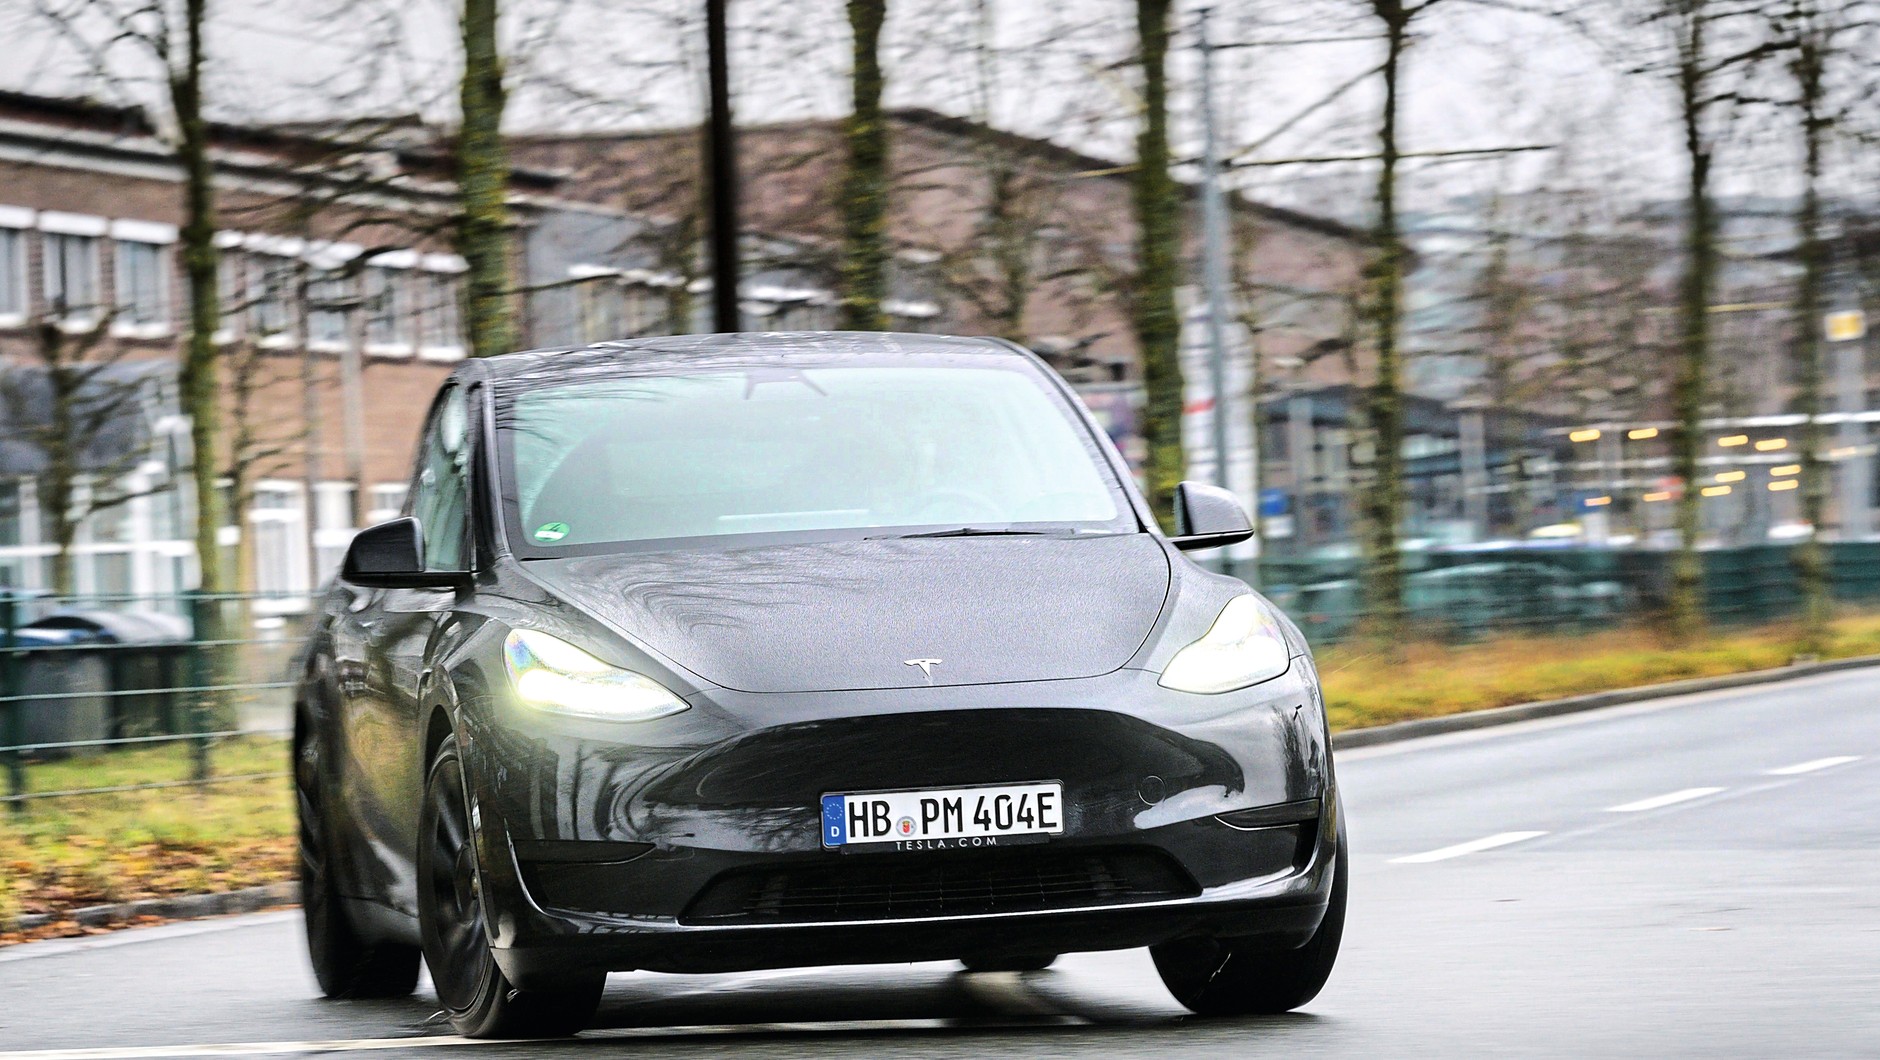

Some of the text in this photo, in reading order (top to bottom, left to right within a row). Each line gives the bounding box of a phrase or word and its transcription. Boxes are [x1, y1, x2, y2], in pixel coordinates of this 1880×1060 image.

[849, 792, 1057, 838] HB PM 404E
[831, 826, 840, 838] D
[896, 837, 997, 851] TESLA.COM
